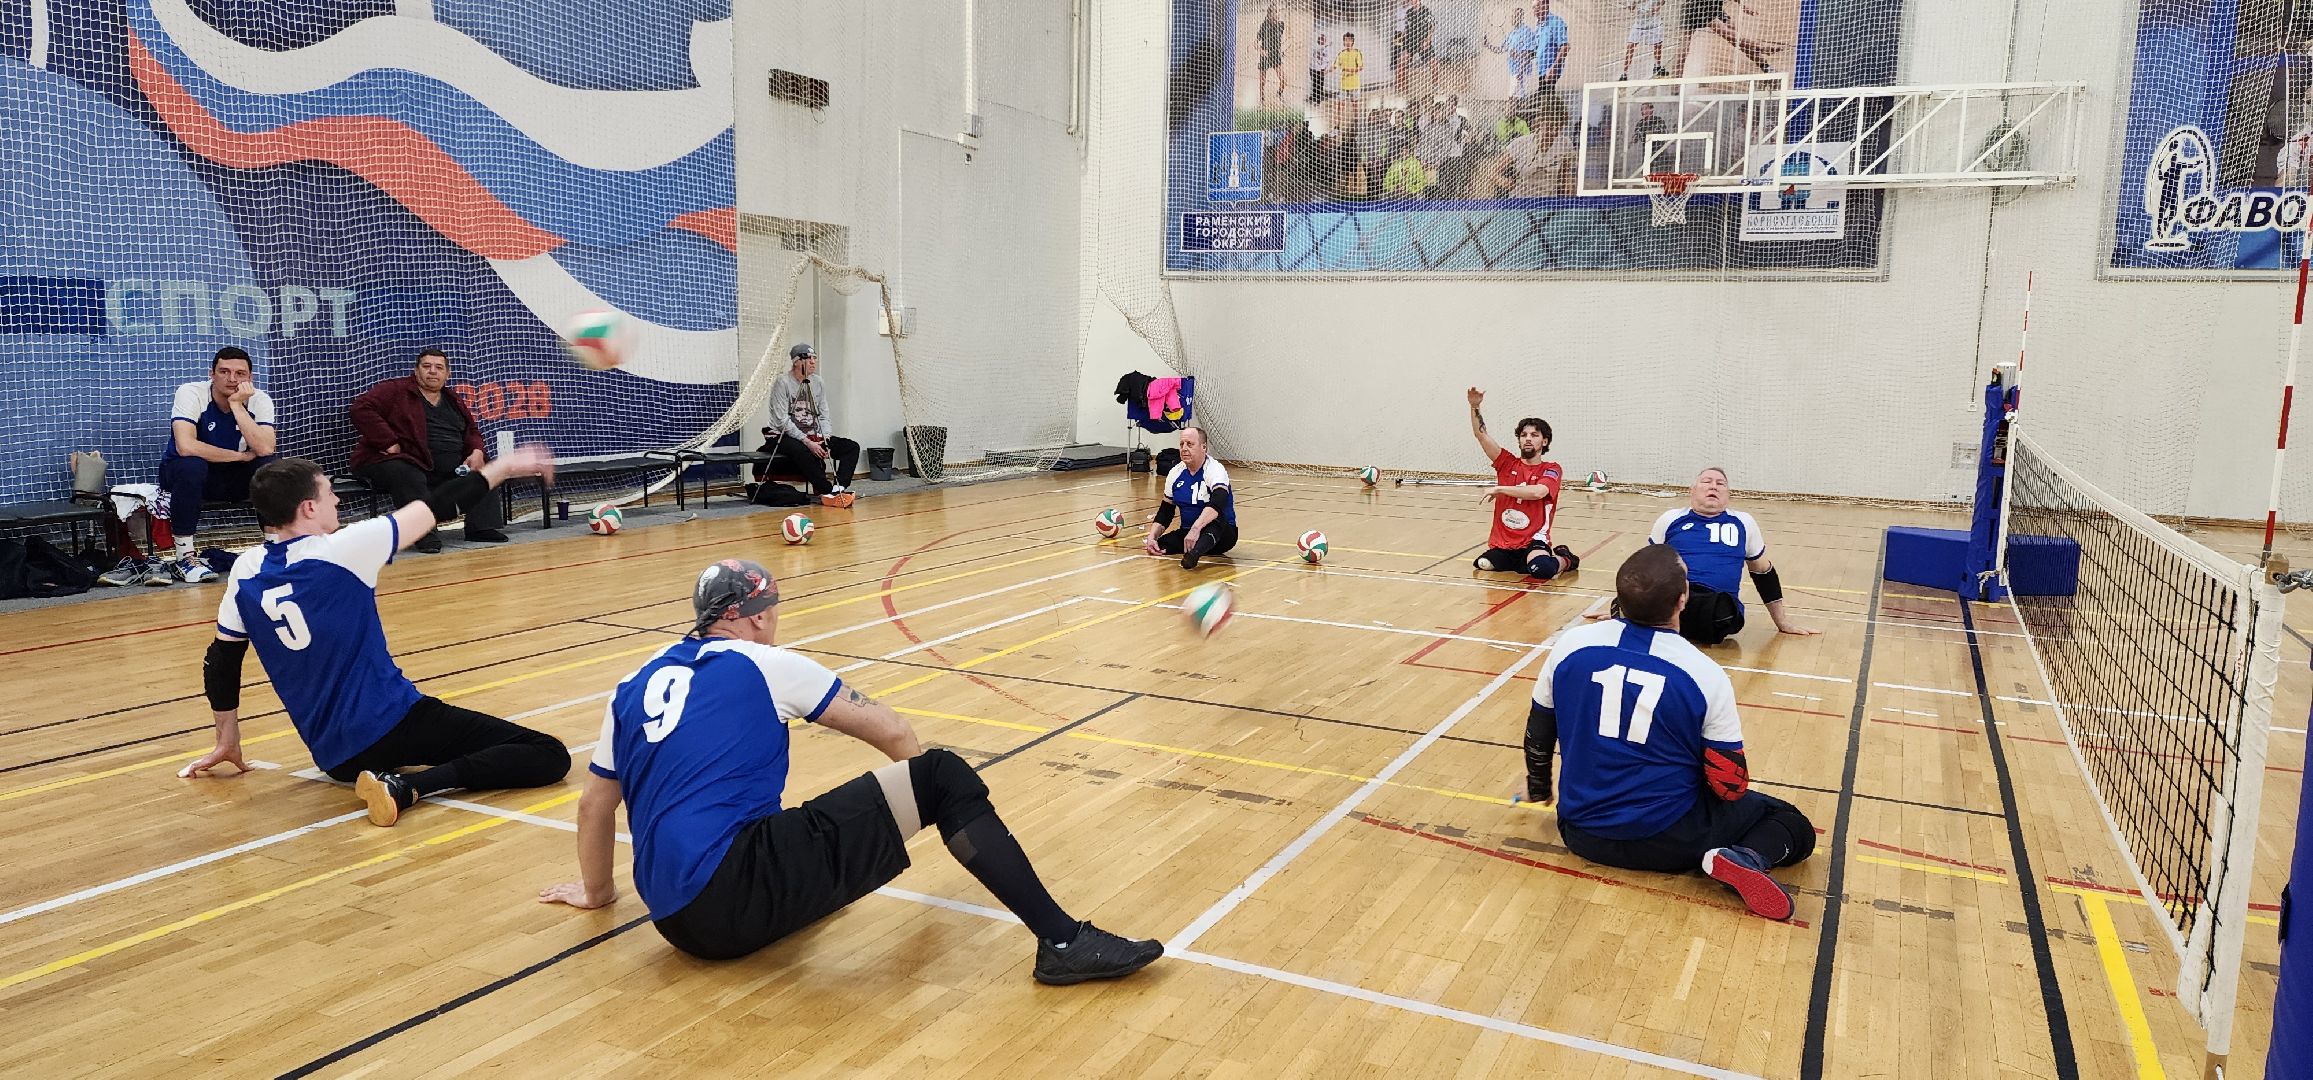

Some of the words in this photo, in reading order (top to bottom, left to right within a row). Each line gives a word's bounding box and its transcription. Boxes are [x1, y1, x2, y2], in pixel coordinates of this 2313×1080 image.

[1195, 214, 1271, 227] РАМЕНСКИЙ
[1195, 227, 1271, 239] ГОРОДСКОЙ
[1212, 238, 1253, 250] ОКРУГ
[105, 279, 356, 338] СПОРТ
[1705, 522, 1739, 547] 10
[260, 583, 312, 651] 5
[642, 665, 695, 743] 9
[1591, 664, 1666, 744] 17
